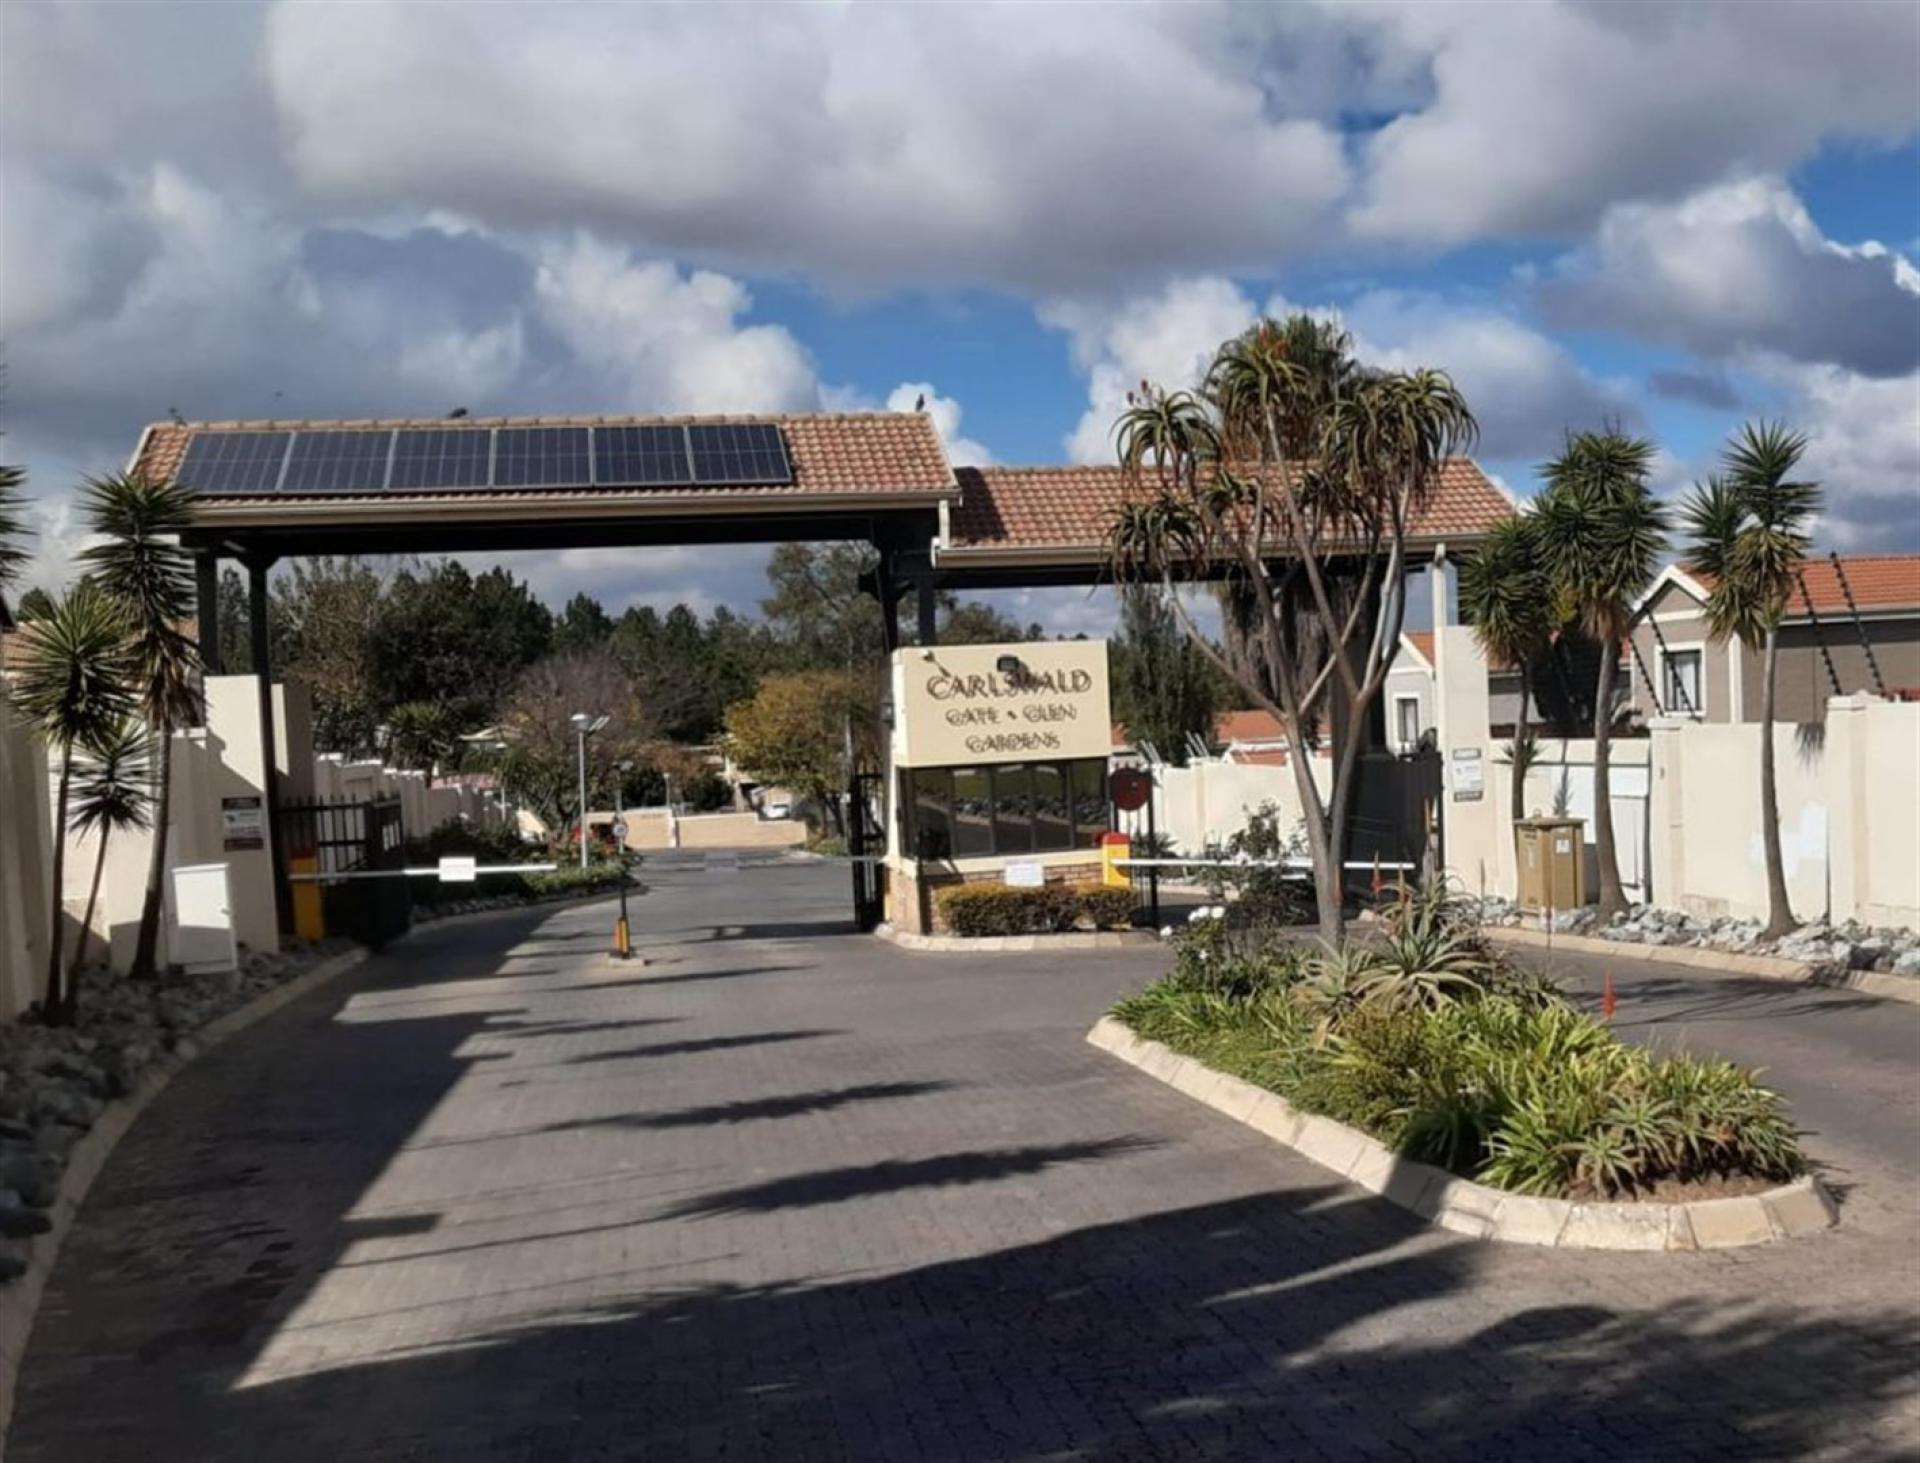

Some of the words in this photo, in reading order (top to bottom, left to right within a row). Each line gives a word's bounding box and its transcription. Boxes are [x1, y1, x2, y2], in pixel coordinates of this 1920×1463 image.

[926, 669, 1092, 700] CARLSWALD
[1022, 704, 1077, 723] GLEN
[965, 731, 1061, 754] GARDENS
